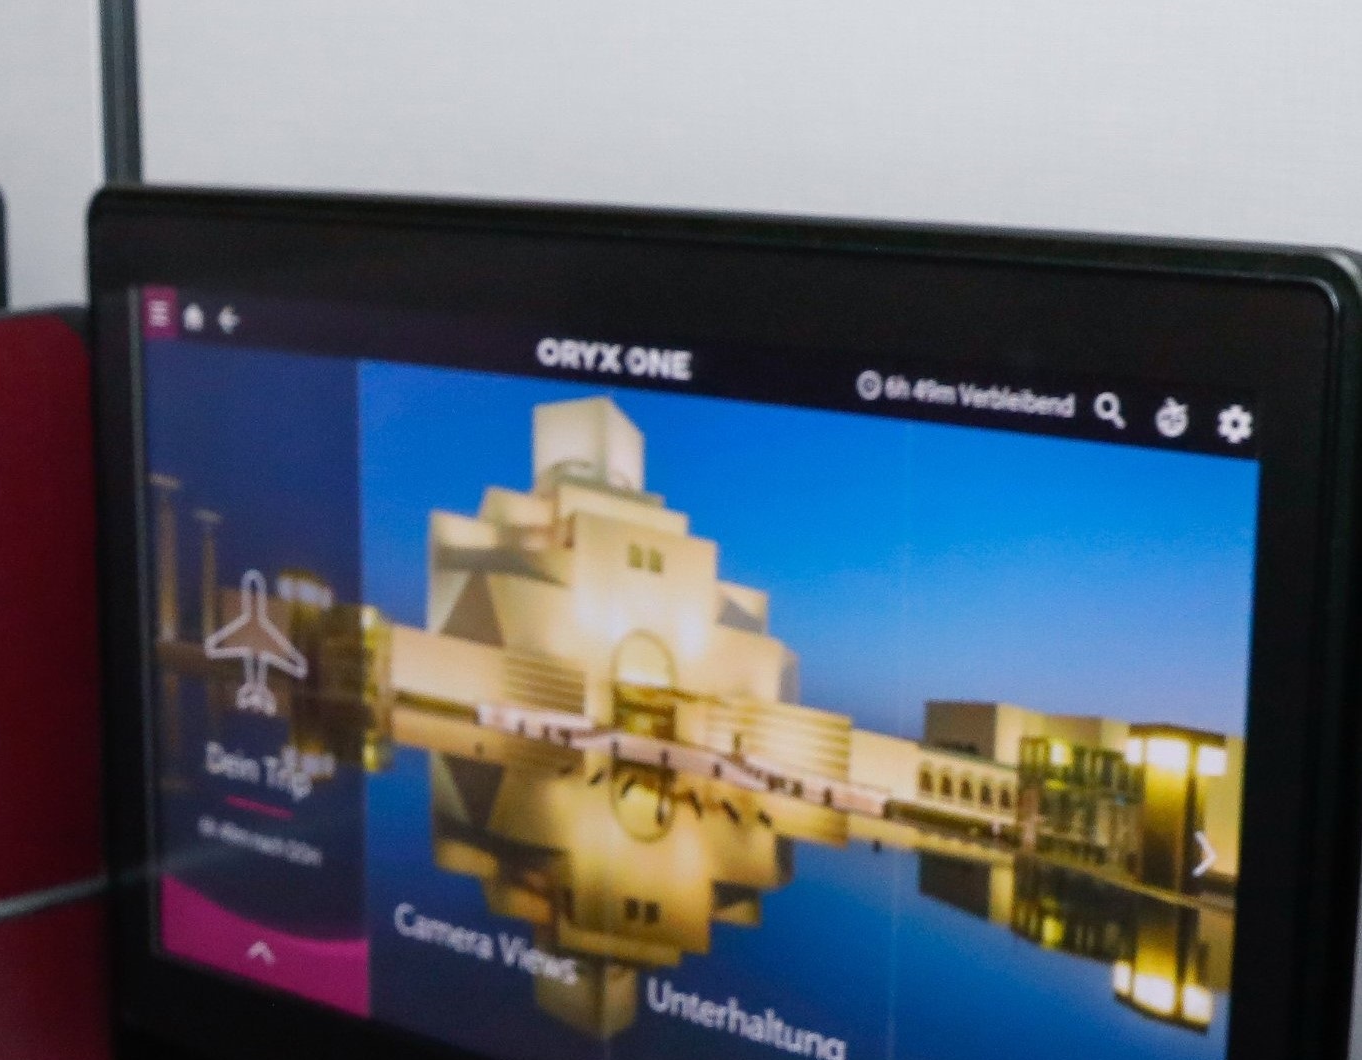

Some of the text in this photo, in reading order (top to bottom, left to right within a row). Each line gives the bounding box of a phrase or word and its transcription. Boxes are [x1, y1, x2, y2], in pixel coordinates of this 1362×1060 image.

[536, 337, 693, 381] ORYX ONE
[205, 741, 260, 784] Dein
[394, 902, 579, 985] Camera Views
